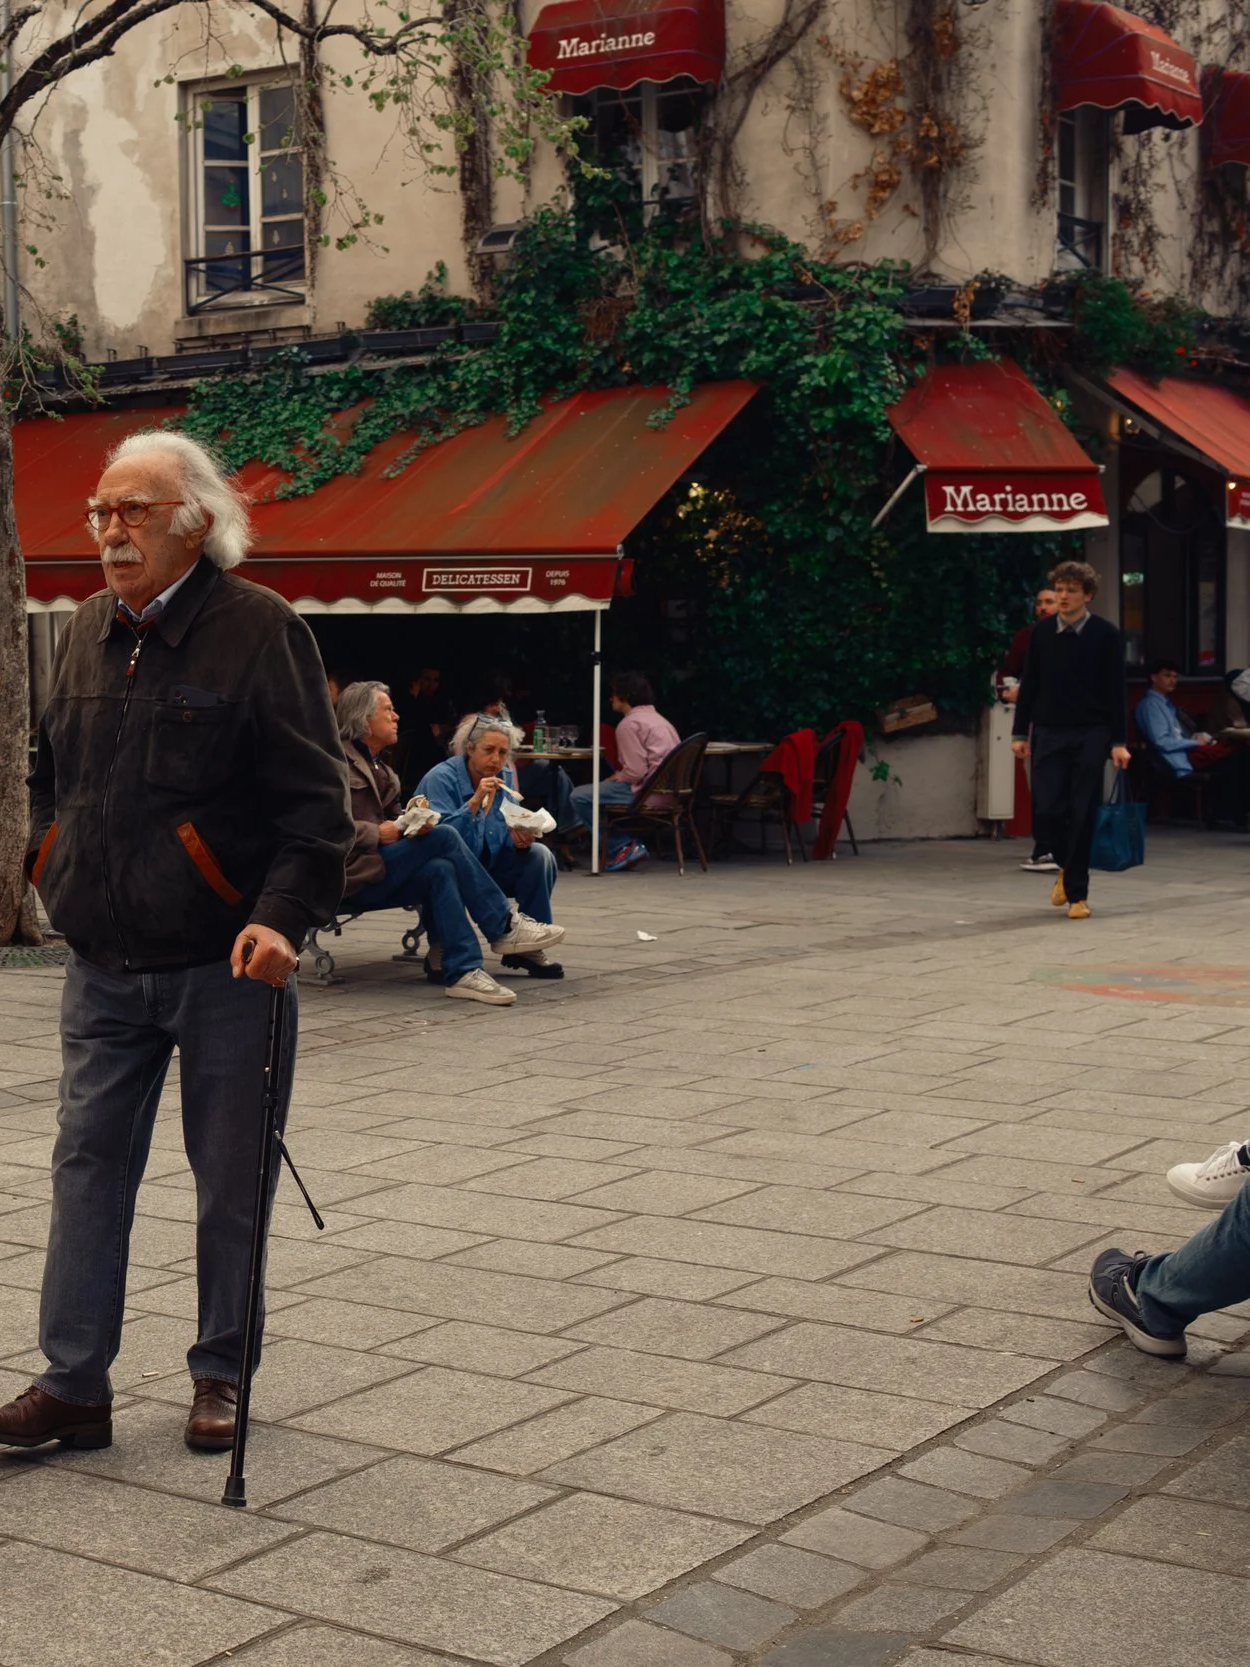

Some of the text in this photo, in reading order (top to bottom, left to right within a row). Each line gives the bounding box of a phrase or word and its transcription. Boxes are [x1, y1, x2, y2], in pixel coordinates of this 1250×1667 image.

[556, 31, 656, 59] Marianne
[941, 485, 1088, 512] Marianne
[432, 574, 520, 585] DELICATESSEN
[545, 570, 570, 578] DEPUIS
[550, 578, 566, 586] 1976
